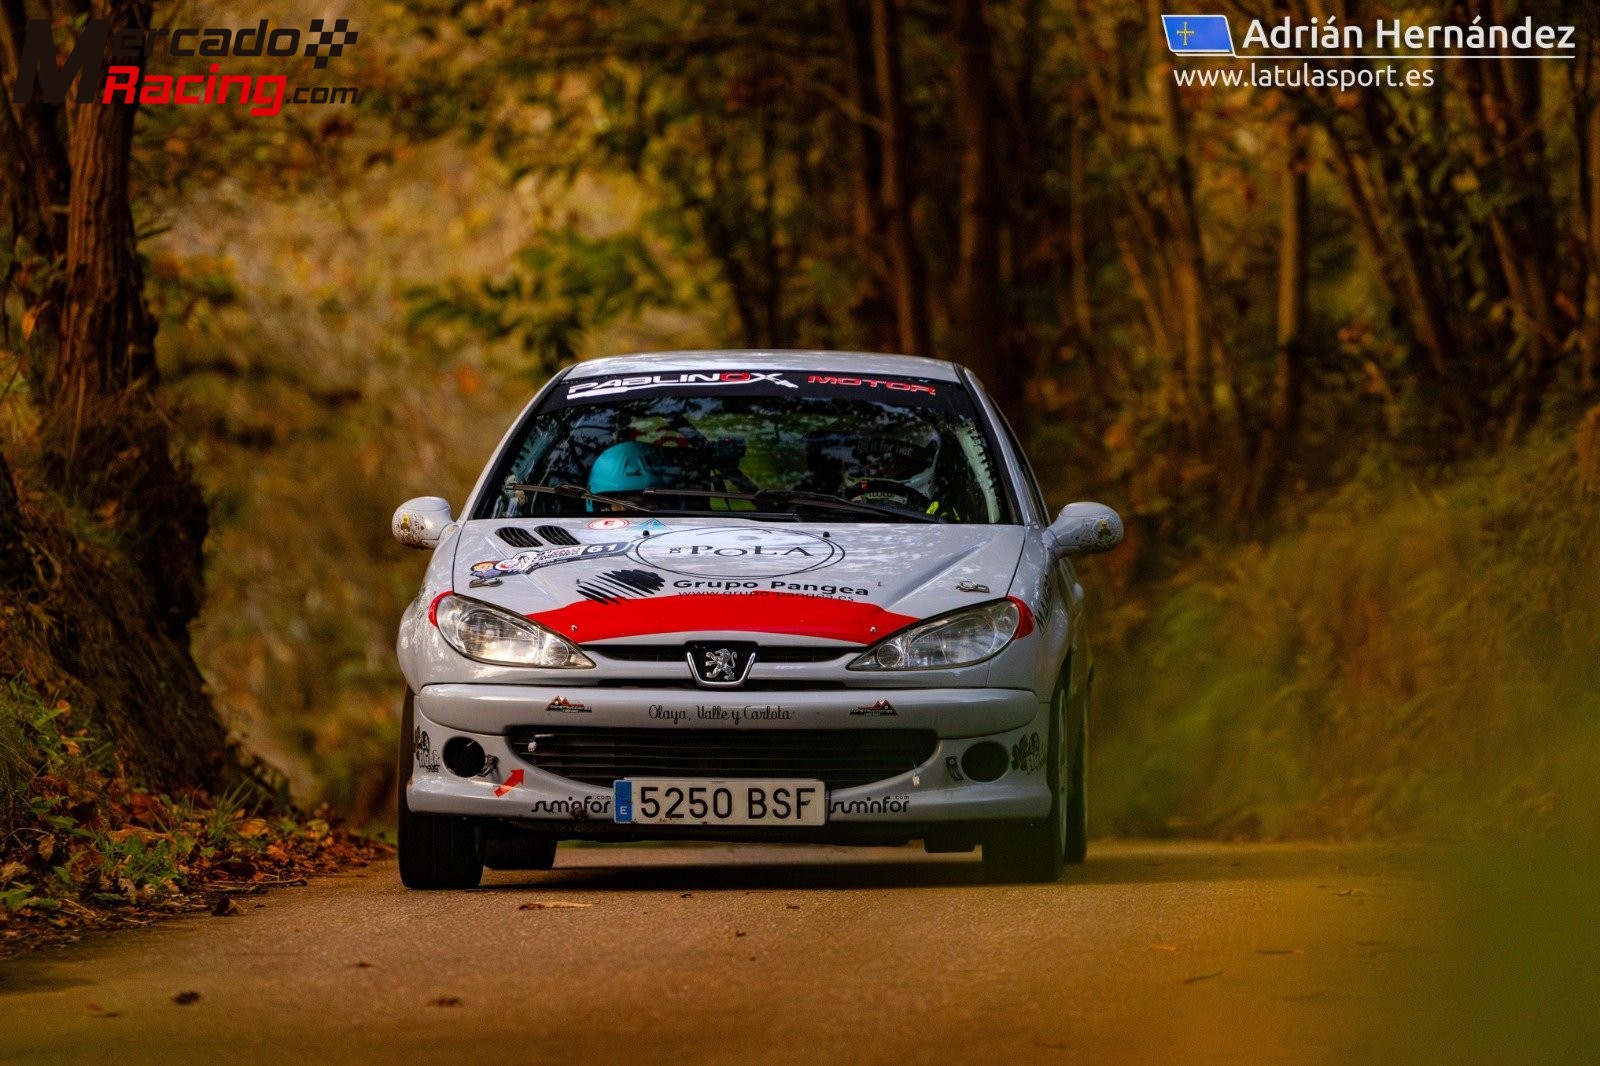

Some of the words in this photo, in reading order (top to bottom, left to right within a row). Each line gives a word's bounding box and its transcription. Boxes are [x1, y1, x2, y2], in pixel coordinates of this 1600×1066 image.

[807, 375, 936, 395] MOTOR
[588, 544, 617, 553] 61
[692, 545, 814, 557] POLA
[673, 580, 759, 590] Grupo
[770, 581, 869, 596] Pangea
[648, 704, 691, 724] Olaya,
[696, 704, 730, 720] Valle
[731, 709, 741, 725] y
[743, 704, 792, 720] Carlota
[619, 806, 627, 815] E
[641, 787, 732, 819] 5250
[747, 787, 816, 819] BSF
[829, 796, 909, 814] suminfor
